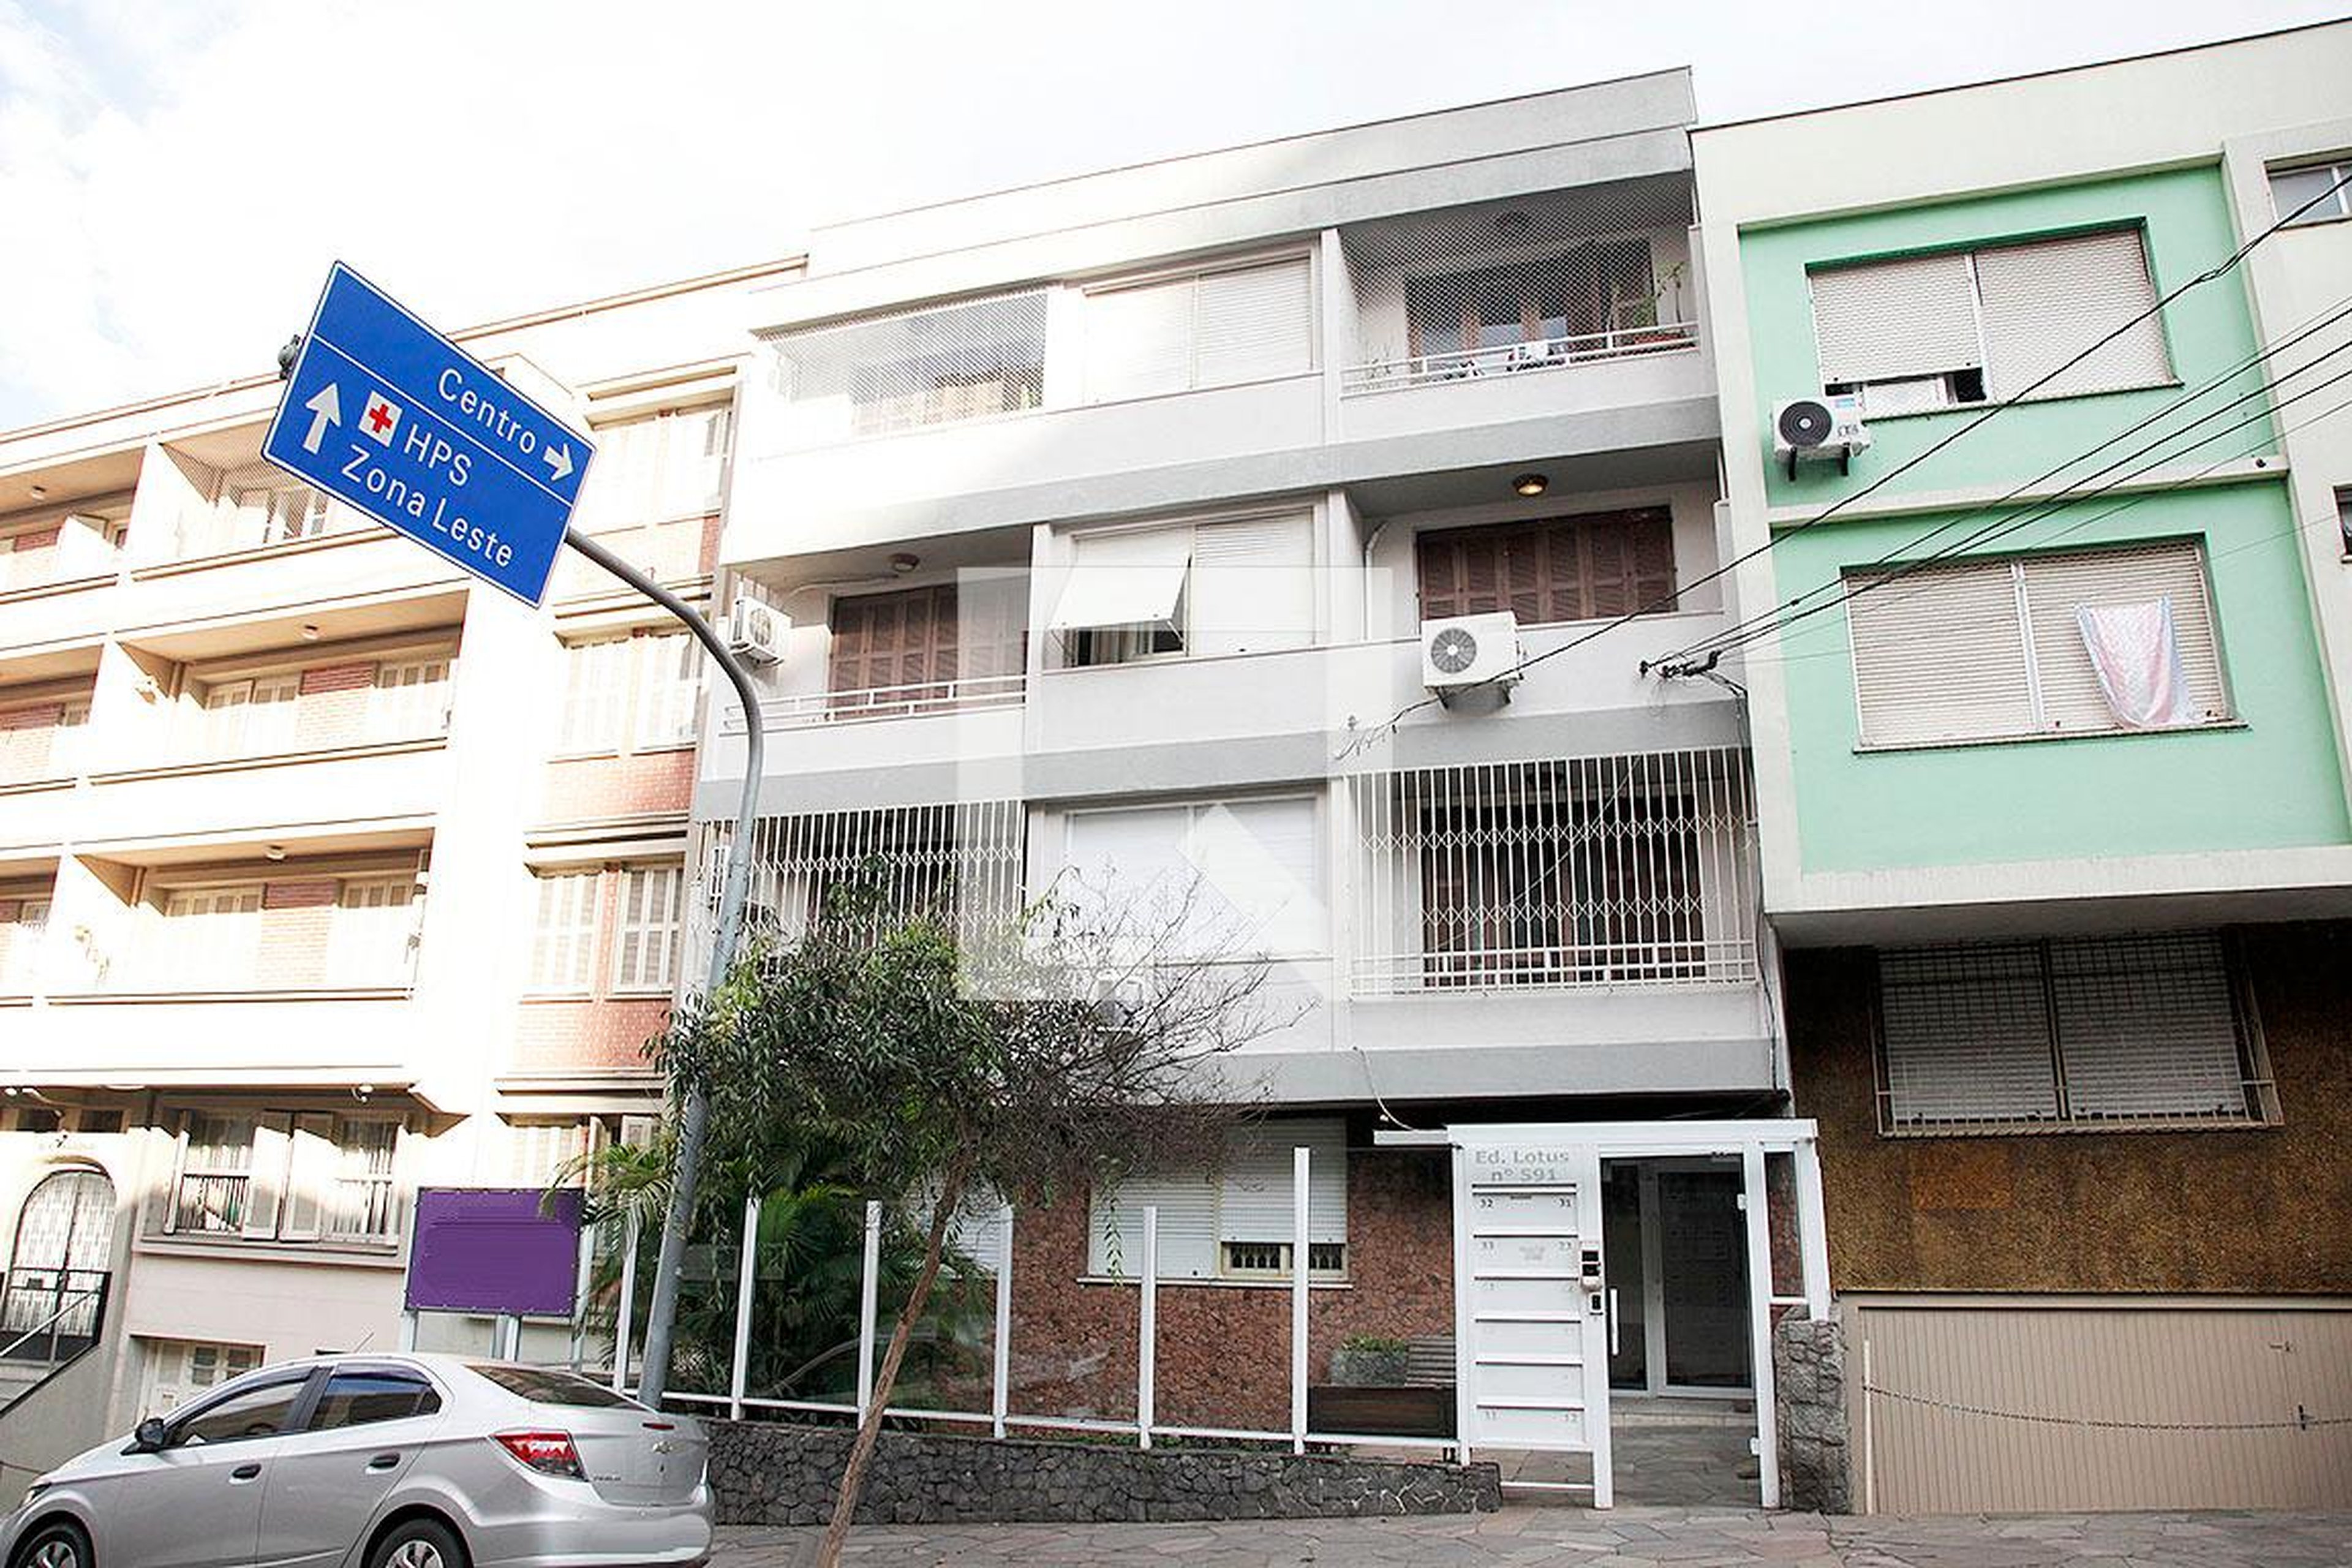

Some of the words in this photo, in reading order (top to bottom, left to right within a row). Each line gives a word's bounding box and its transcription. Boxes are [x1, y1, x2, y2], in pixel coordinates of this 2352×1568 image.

[439, 368, 536, 454] Centro
[404, 423, 472, 486] HPS
[341, 443, 426, 518] Zona
[432, 497, 513, 567] Leste
[1476, 1150, 1506, 1164] Ed.
[1513, 1150, 1569, 1164] Lotus
[1520, 1167, 1556, 1182] 591
